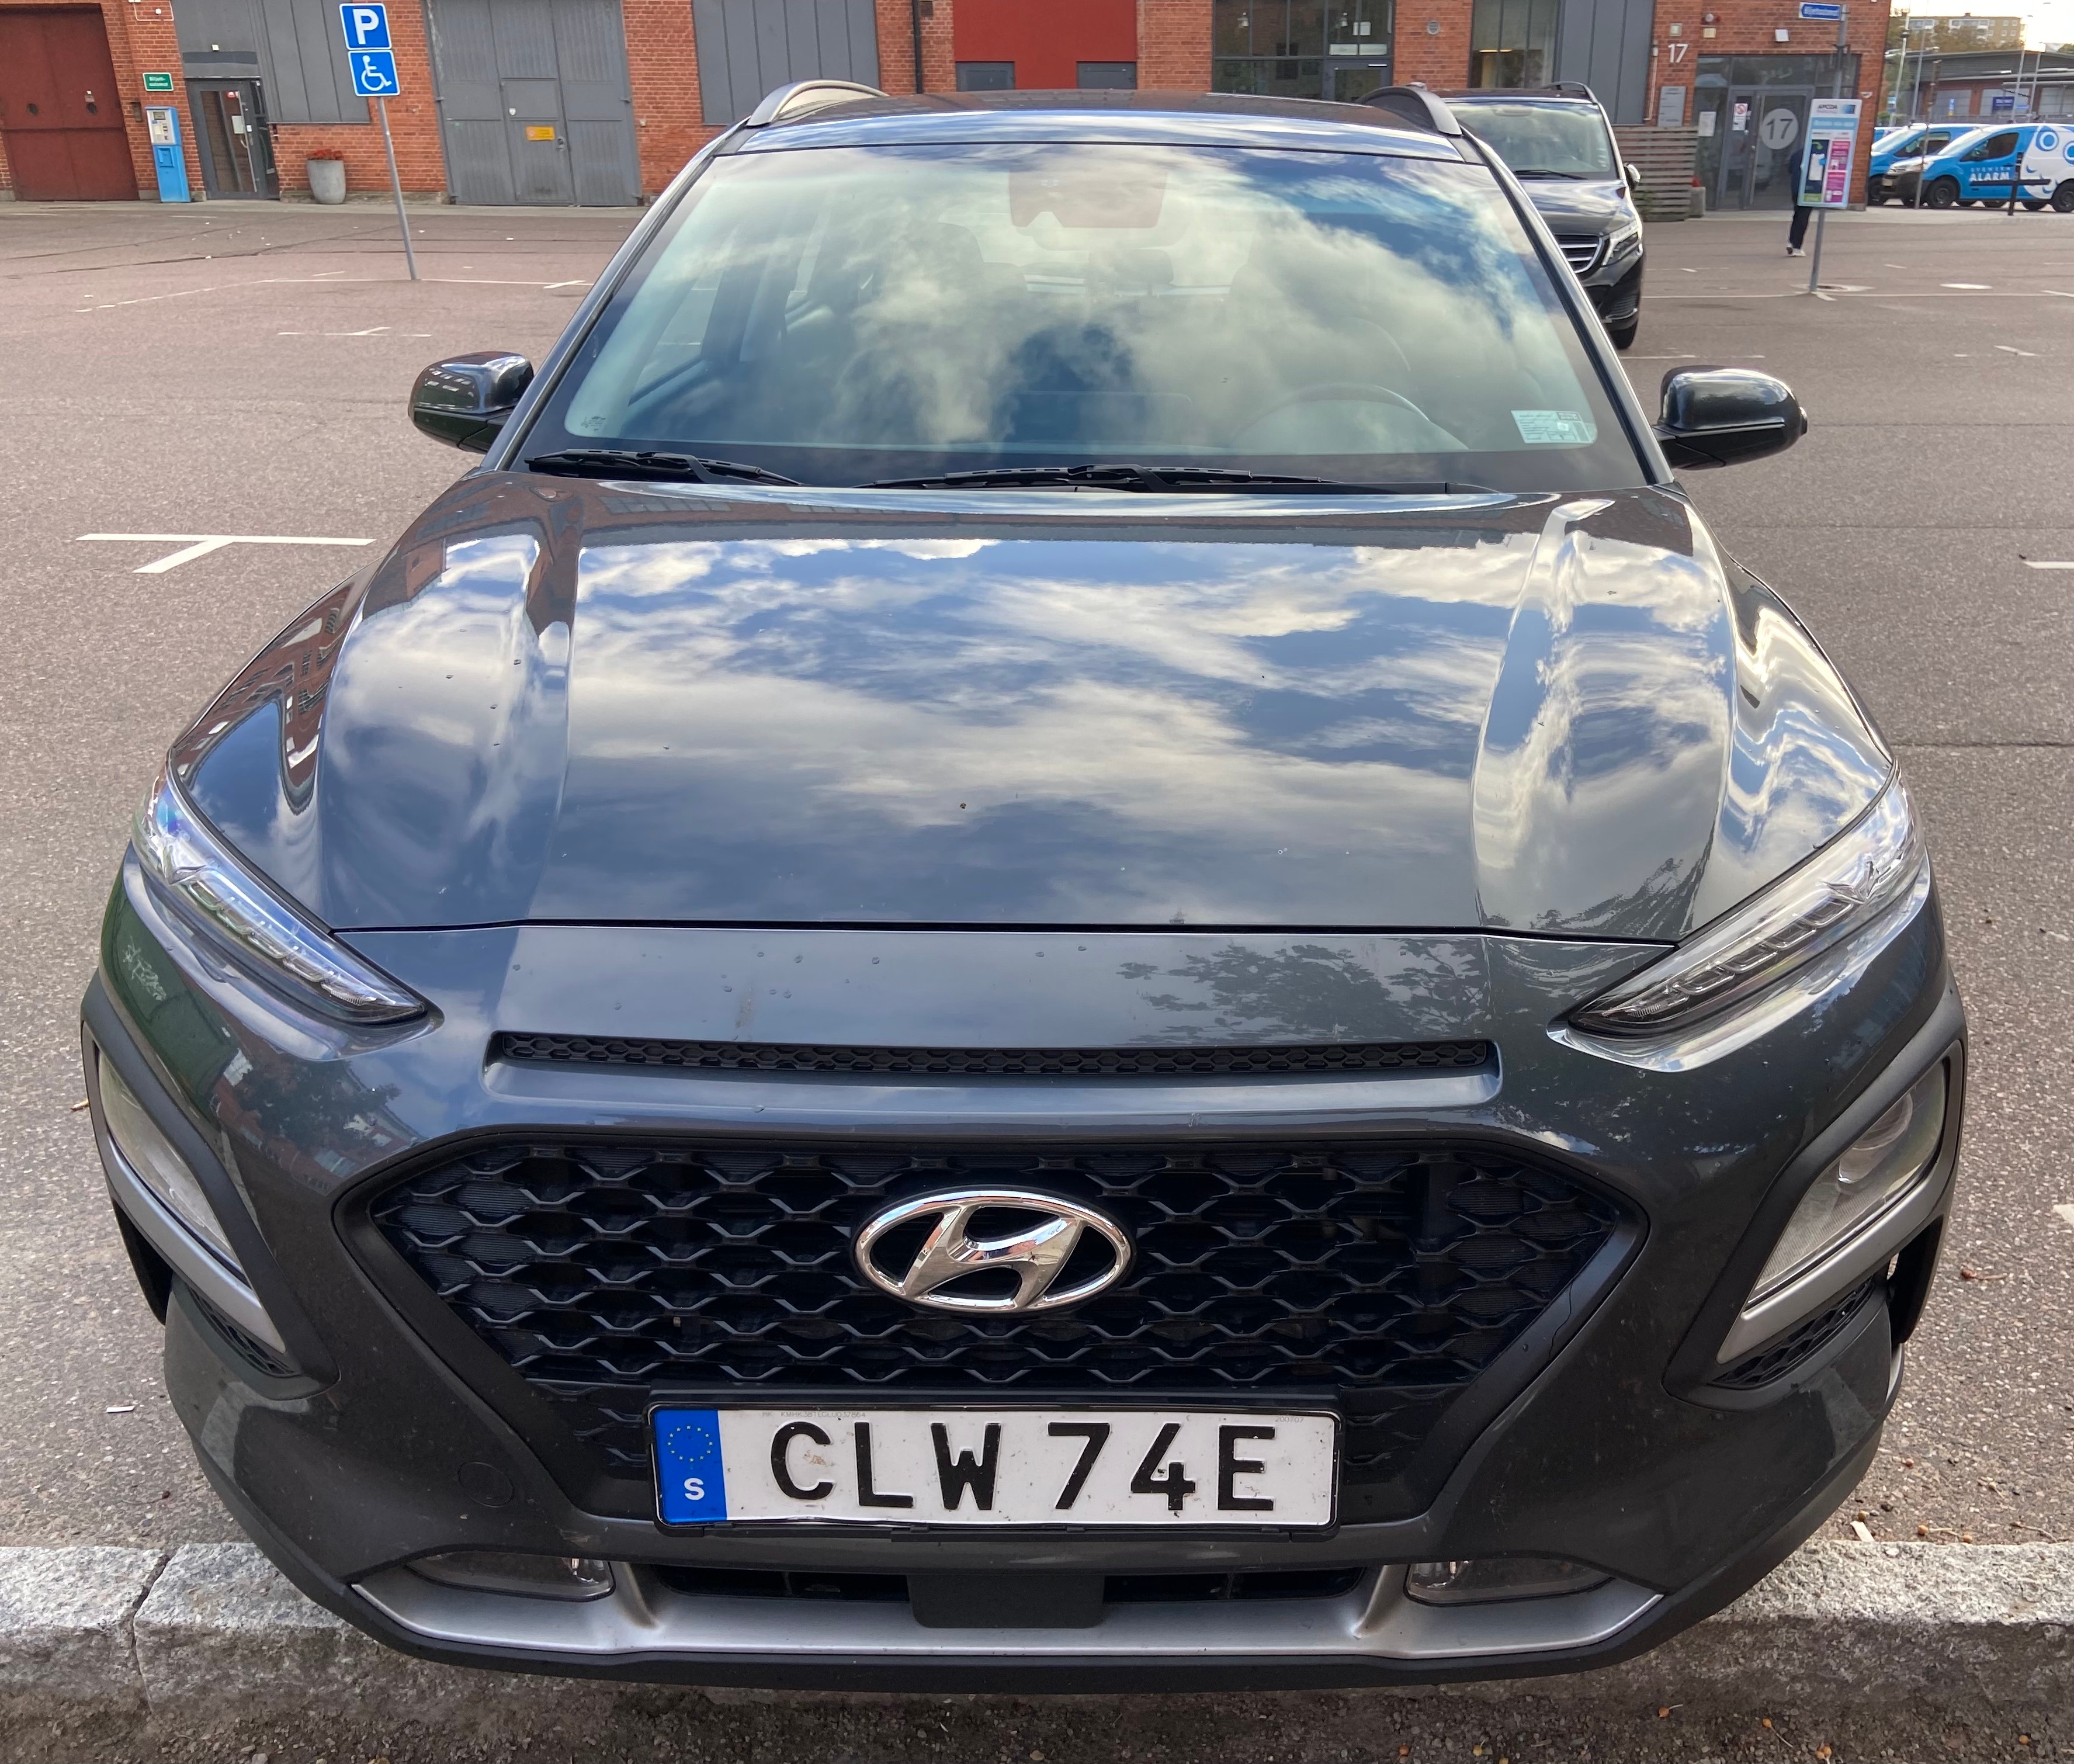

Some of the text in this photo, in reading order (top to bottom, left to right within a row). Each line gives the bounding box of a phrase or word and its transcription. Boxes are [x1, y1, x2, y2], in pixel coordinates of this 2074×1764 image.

[352, 8, 379, 45] P
[1668, 43, 1688, 63] 17
[1766, 118, 1794, 140] 17
[1969, 172, 2010, 181] ALARM
[771, 1421, 1275, 1510] CLW 74E
[684, 1477, 705, 1500] S
